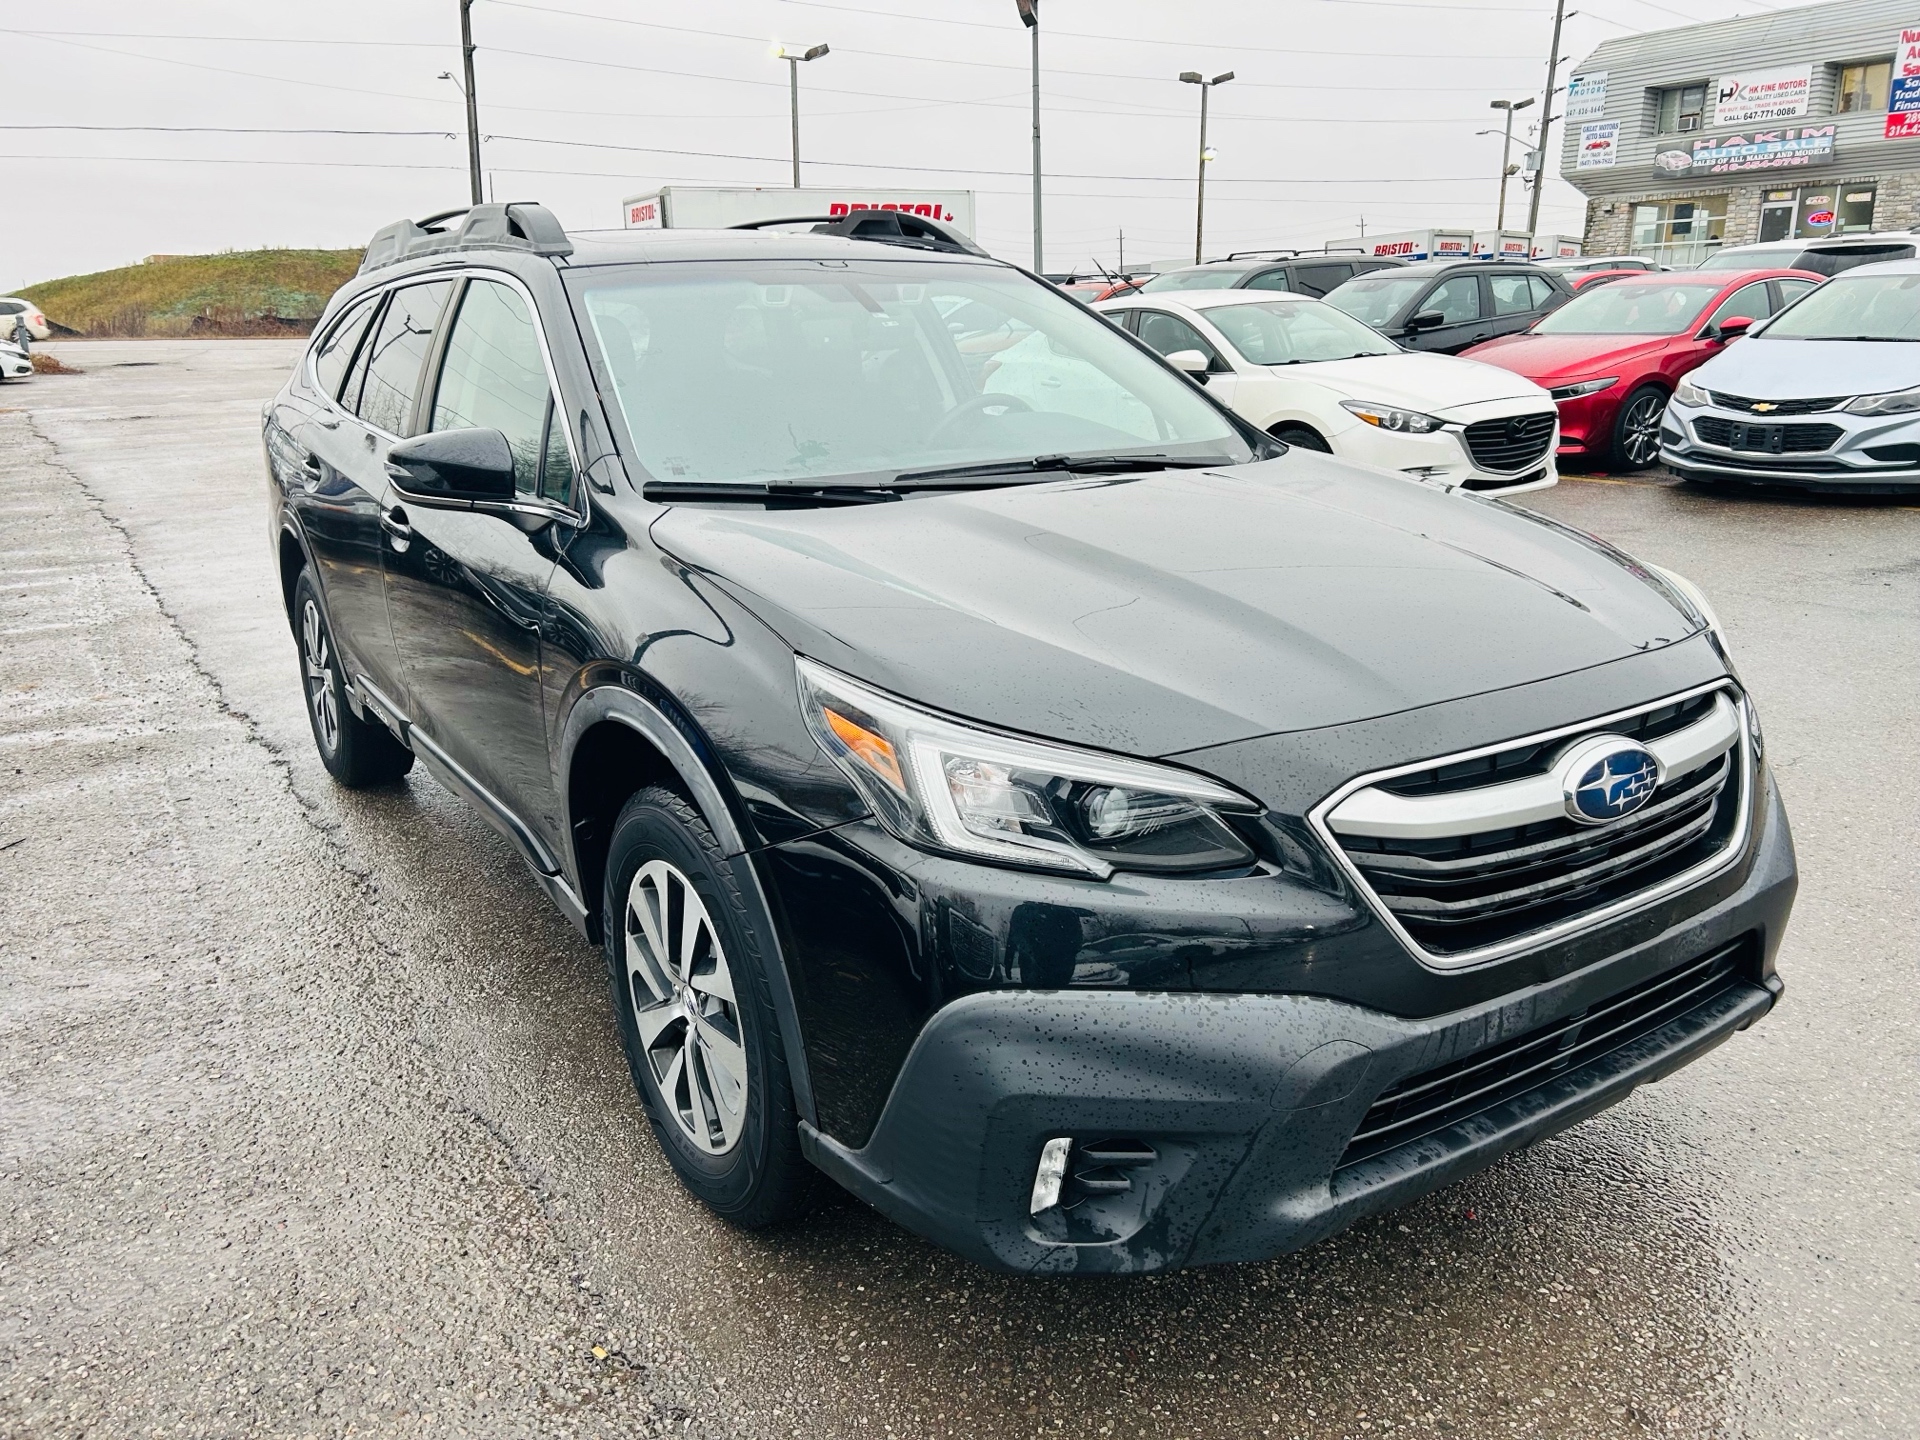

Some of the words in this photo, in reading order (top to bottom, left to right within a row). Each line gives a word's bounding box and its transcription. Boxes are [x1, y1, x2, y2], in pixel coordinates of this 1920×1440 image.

[1592, 78, 1607, 86] TRADE
[1748, 85, 1759, 95] HK
[1760, 83, 1776, 93] FINE
[1777, 79, 1808, 91] MOTORS
[1904, 78, 1920, 88] Sa
[1574, 85, 1606, 97] MOTORS
[1748, 93, 1772, 101] QUALITY
[1773, 90, 1789, 99] USED
[1790, 89, 1806, 97] CARS
[1754, 101, 1771, 109] TRADE
[1743, 106, 1797, 121] 647-771-0086
[1582, 124, 1598, 133] GREAT
[1598, 122, 1619, 131] MOTORS
[1585, 132, 1598, 140] AUTO
[1598, 130, 1613, 139] SALES
[1693, 126, 1835, 150] HAKIM
[1693, 143, 1758, 161] AUTO
[1767, 137, 1831, 153] SALE
[1692, 158, 1717, 167] SALES
[1717, 157, 1728, 165] OF
[1729, 155, 1745, 163] ALL
[1746, 152, 1774, 162] MAKES
[1775, 150, 1793, 159] AND
[1794, 147, 1831, 157] MODELS
[631, 203, 655, 224] BRISTOL
[1811, 212, 1836, 223] OPEN
[1375, 241, 1414, 256] BRISTOL
[1439, 242, 1463, 251] BRISTOL
